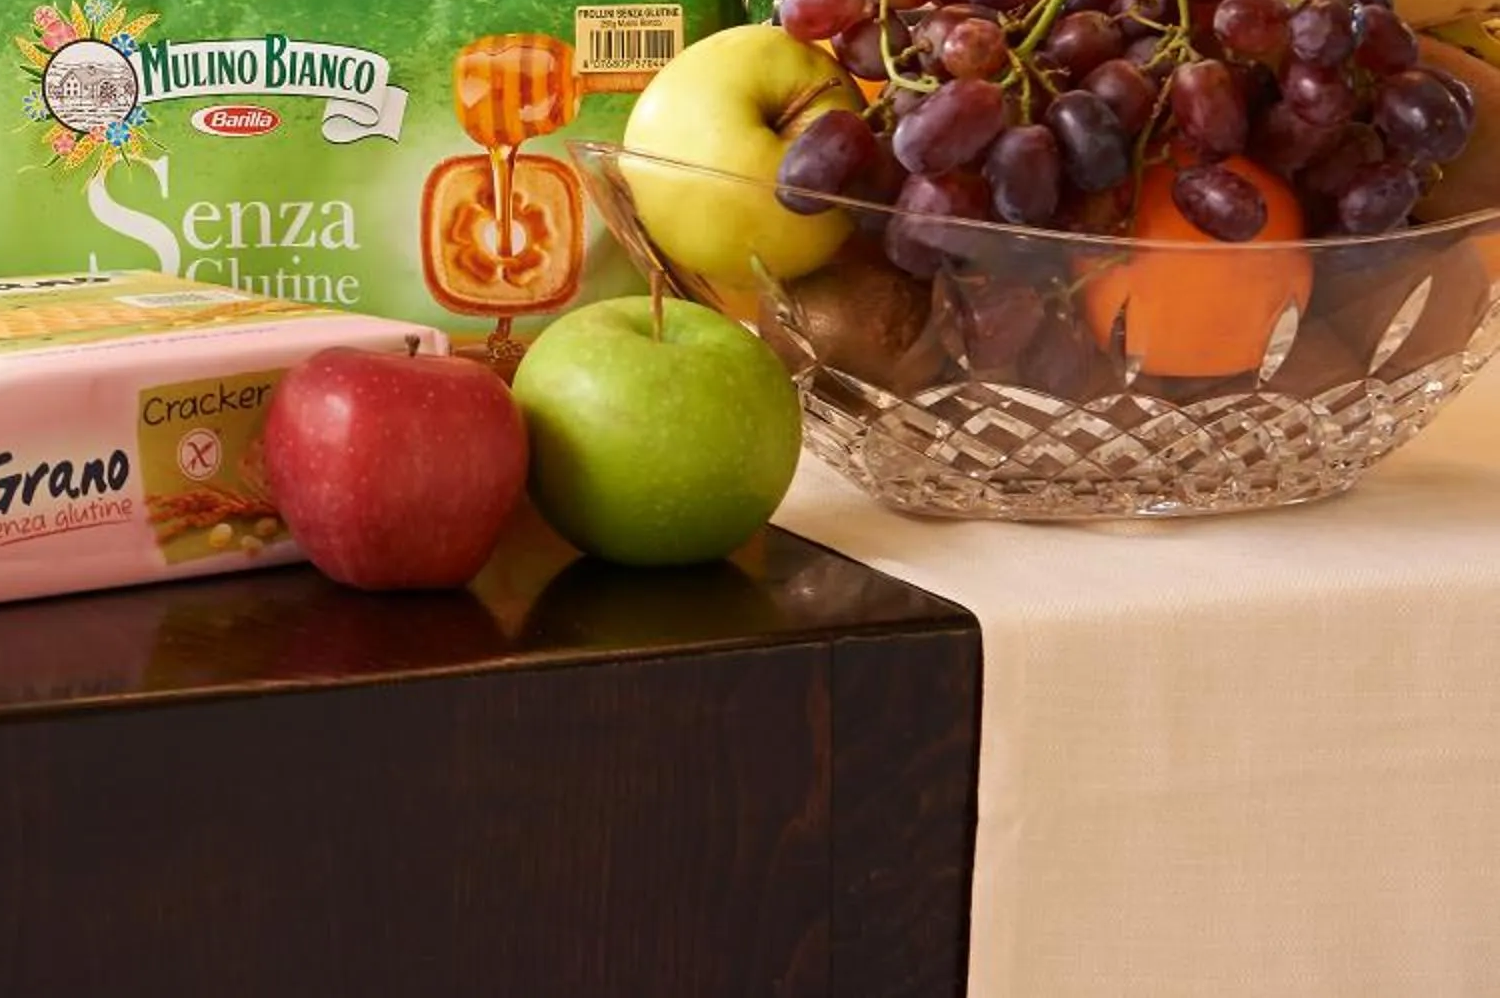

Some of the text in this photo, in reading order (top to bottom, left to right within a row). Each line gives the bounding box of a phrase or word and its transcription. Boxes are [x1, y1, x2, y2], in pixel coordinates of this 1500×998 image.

[139, 33, 376, 96] MULINO BIANCO
[211, 111, 274, 128] Barilla
[88, 155, 361, 279] Senza
[142, 382, 272, 426] Cracker
[53, 495, 134, 531] glutine
